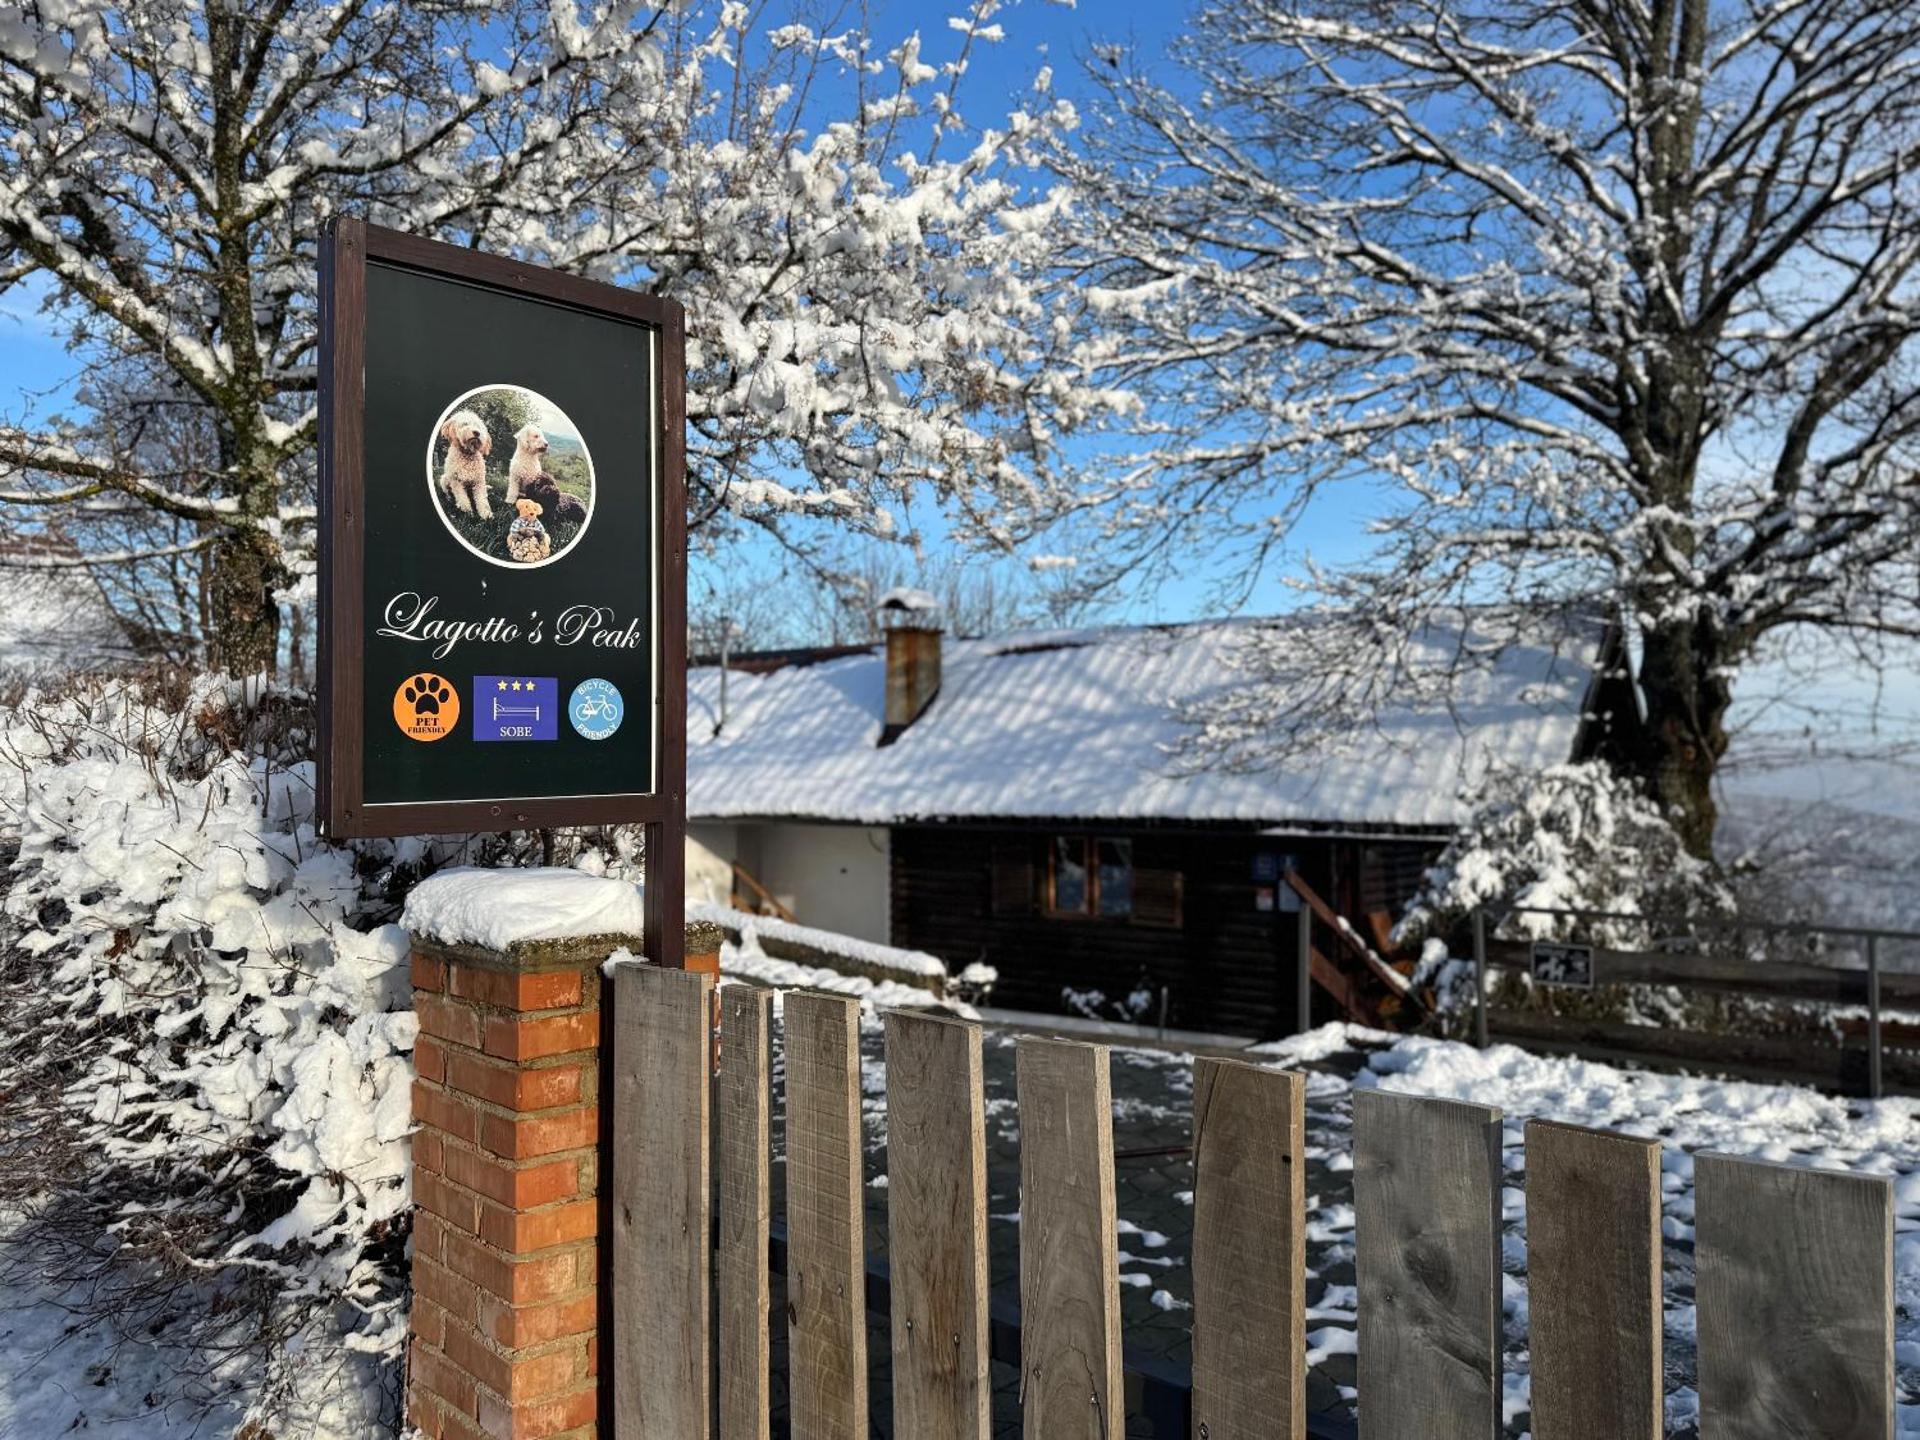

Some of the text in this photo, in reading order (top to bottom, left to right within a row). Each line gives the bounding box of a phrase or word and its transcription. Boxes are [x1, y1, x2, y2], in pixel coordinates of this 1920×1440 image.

[376, 591, 641, 660] Lagotto's Peak
[577, 680, 616, 696] BICYCLE
[416, 717, 439, 726] PET
[407, 726, 446, 734] FRIENDLY
[499, 726, 533, 737] SOBE
[576, 723, 618, 740] FRIENDLY
